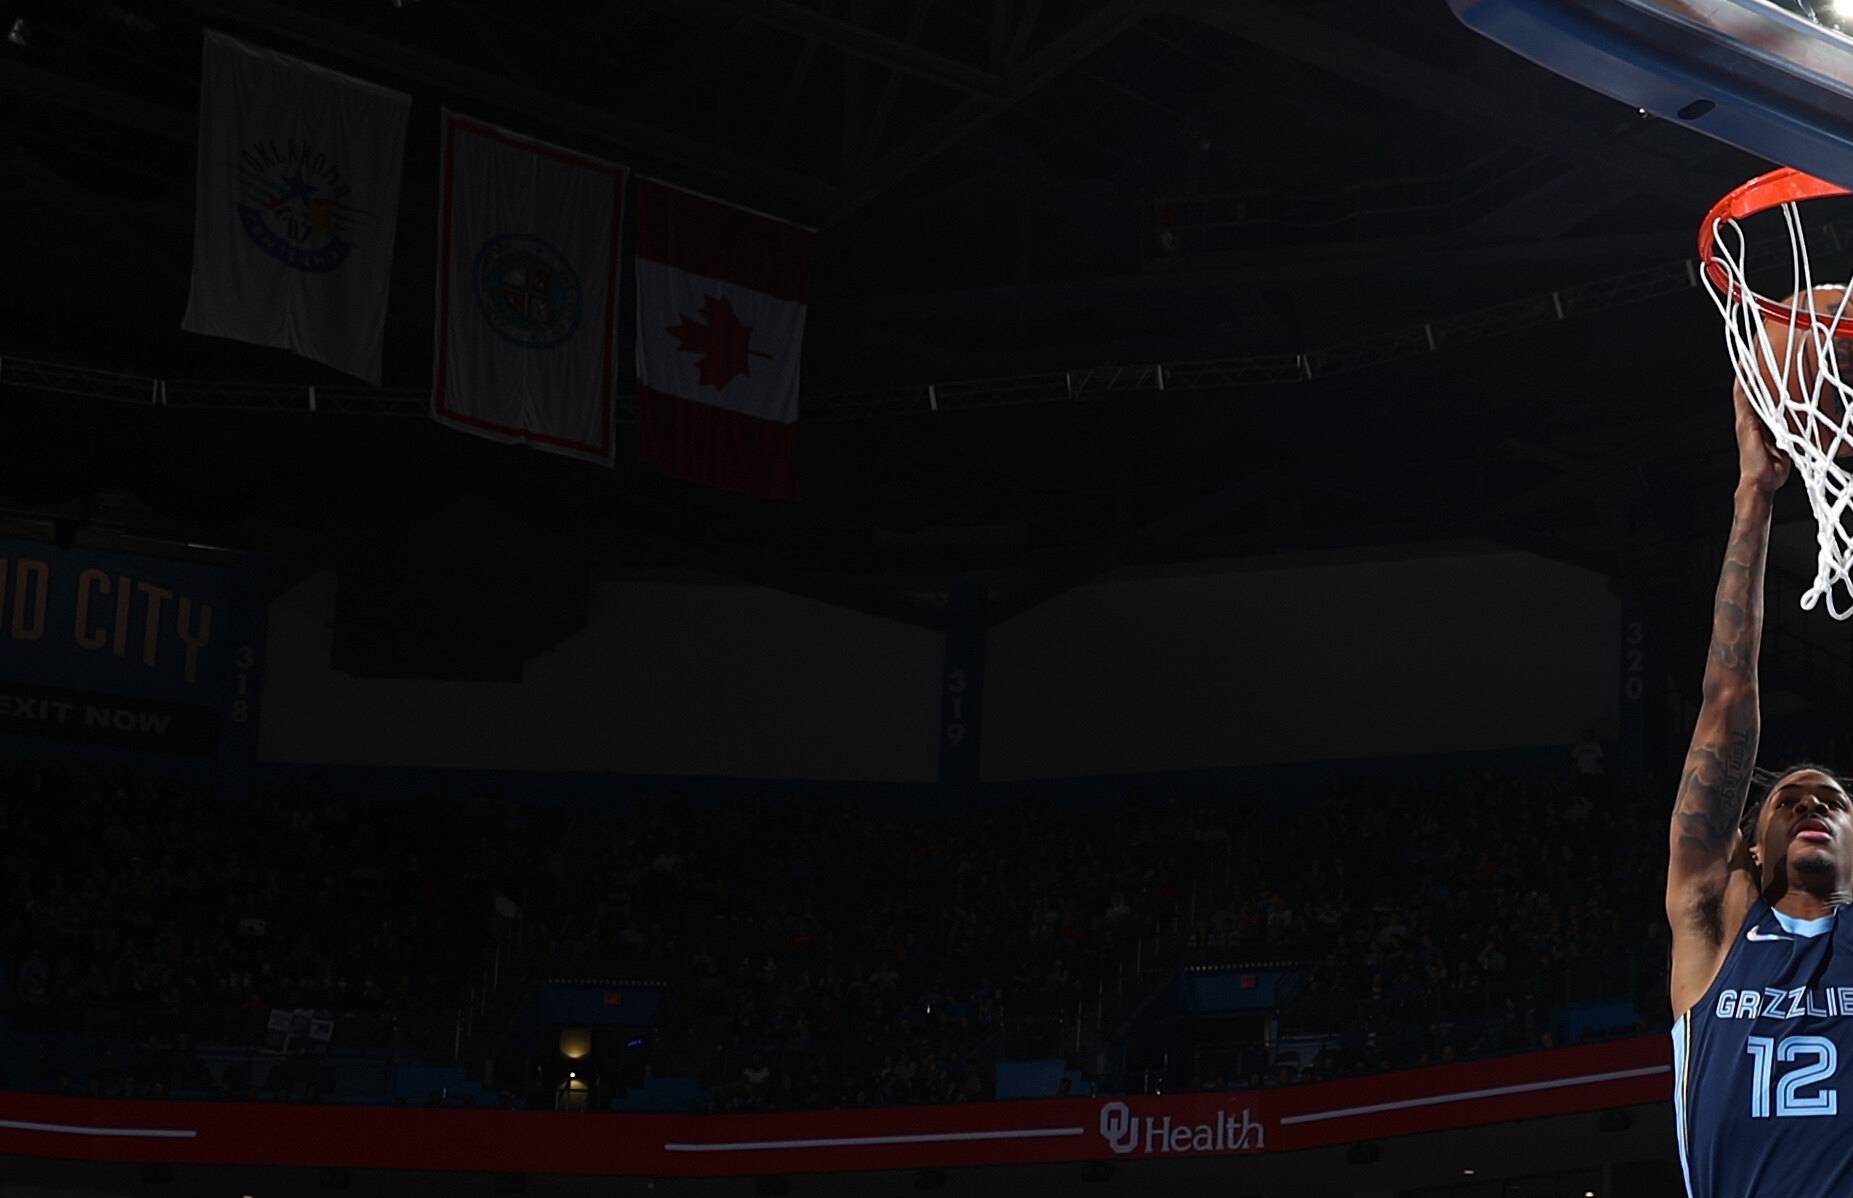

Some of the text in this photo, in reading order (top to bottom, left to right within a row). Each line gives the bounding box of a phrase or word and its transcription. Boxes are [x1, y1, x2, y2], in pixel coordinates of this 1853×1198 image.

[75, 567, 213, 684] CITY
[1626, 621, 1643, 700] 320
[84, 702, 171, 735] NOW
[1746, 1034, 1840, 1119] 12
[1145, 1109, 1265, 1153] Health
